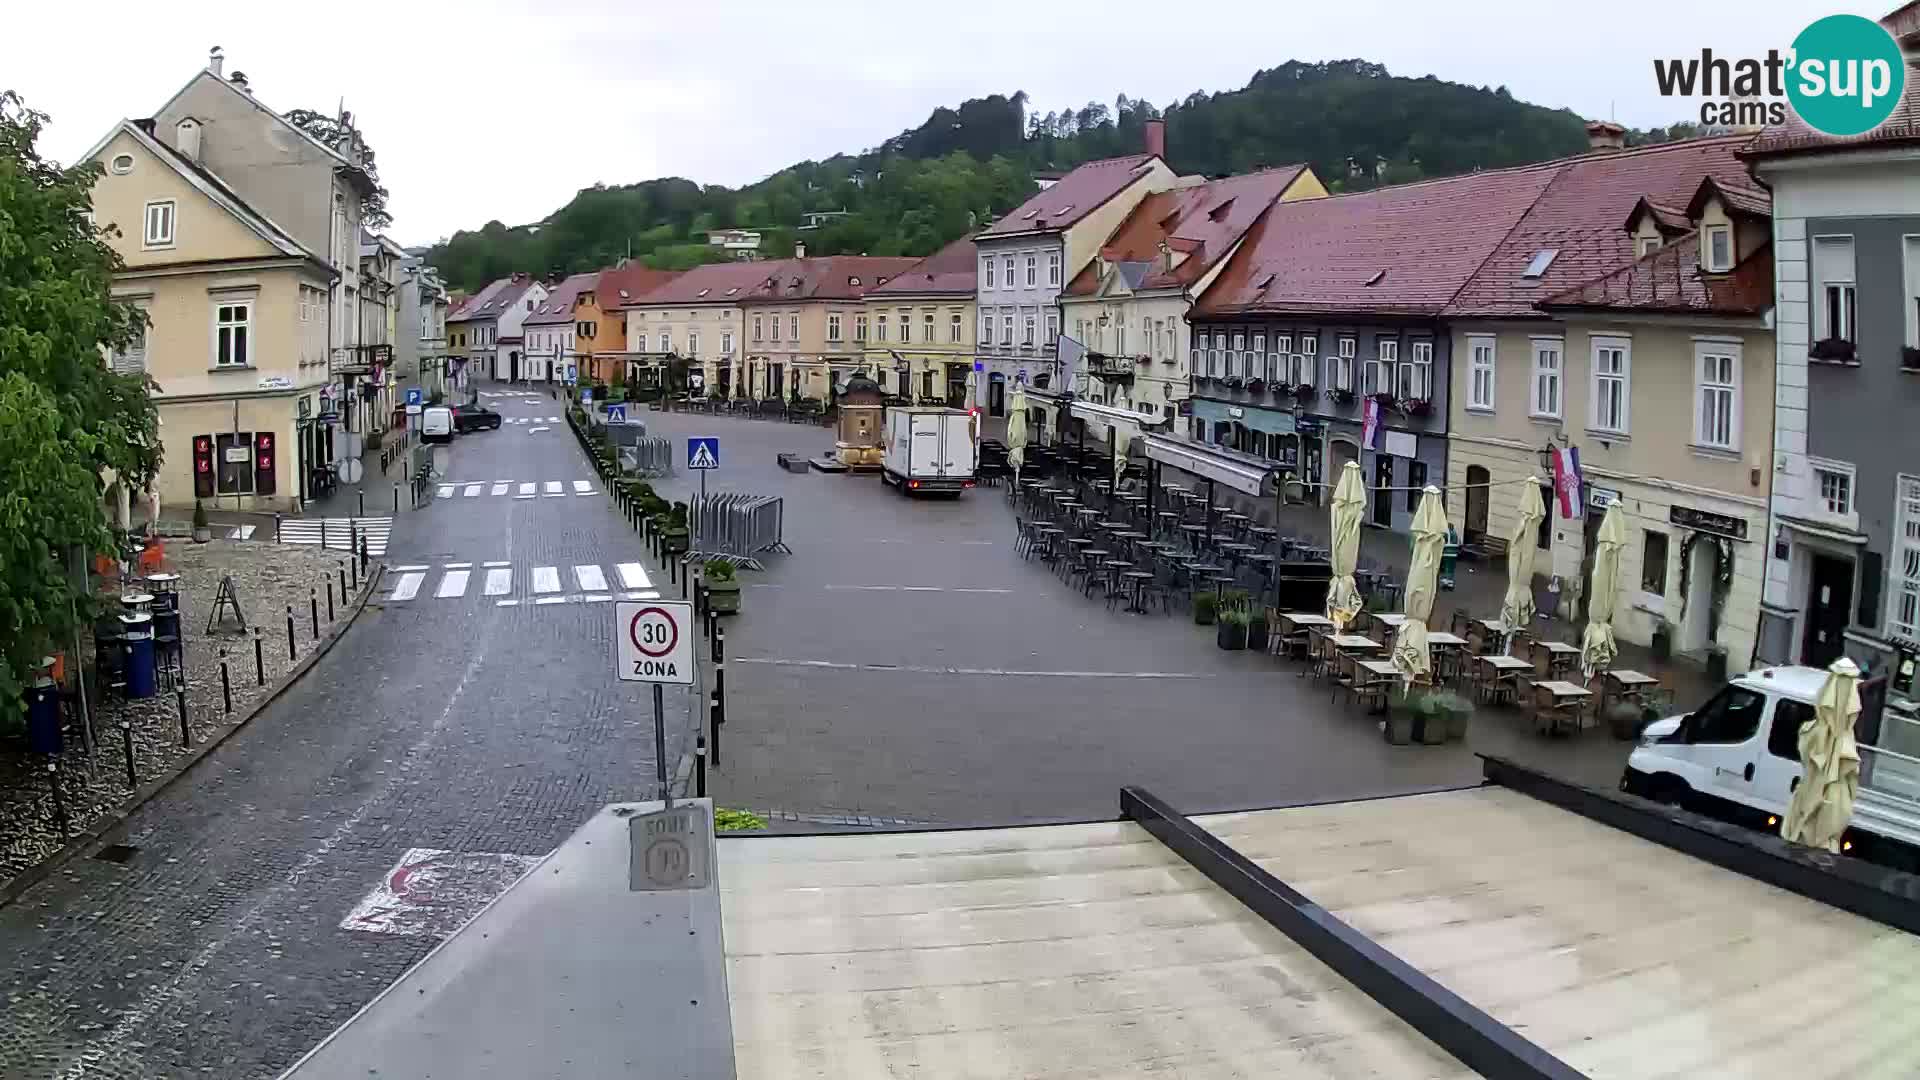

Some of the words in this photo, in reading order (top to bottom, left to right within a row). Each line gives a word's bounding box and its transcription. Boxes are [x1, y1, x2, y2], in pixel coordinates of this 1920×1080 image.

[409, 391, 418, 402] P
[643, 623, 667, 644] 30
[633, 660, 678, 677] ZONA
